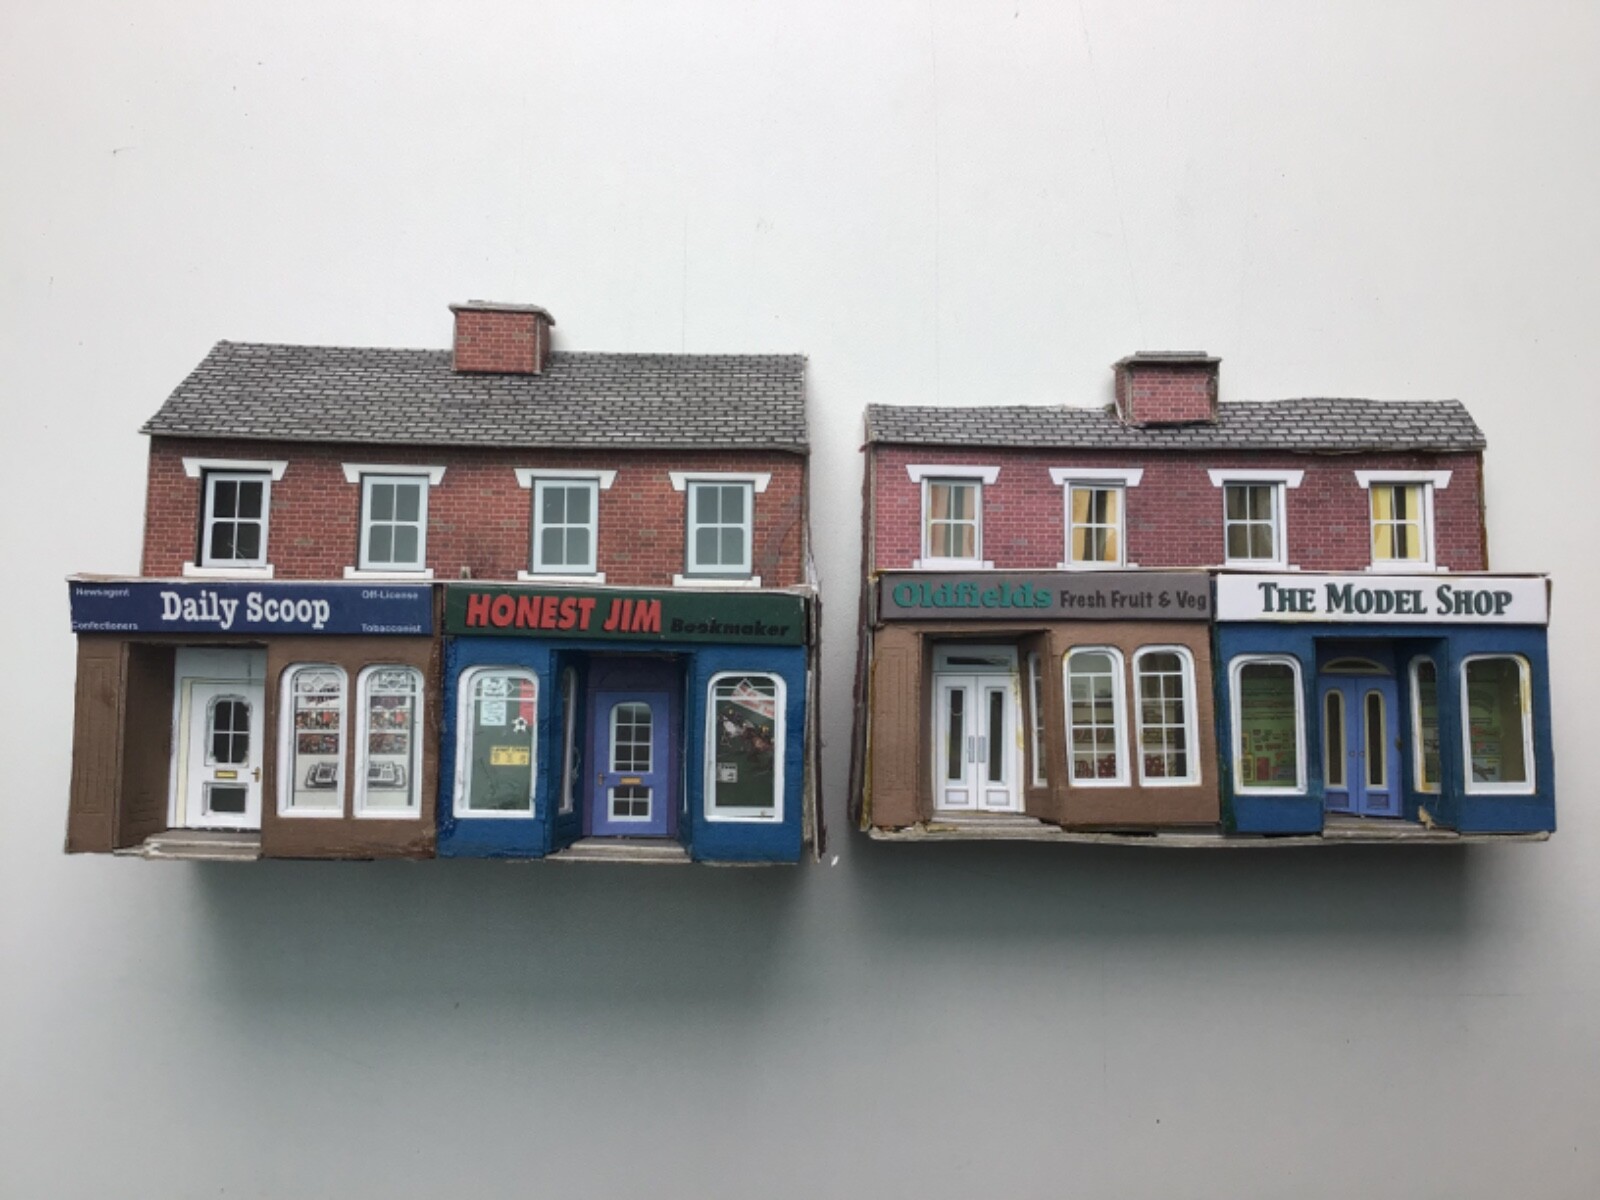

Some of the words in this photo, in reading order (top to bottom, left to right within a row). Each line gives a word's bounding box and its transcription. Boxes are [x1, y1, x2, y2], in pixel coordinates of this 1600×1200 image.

[75, 587, 130, 599] Newsagent
[892, 581, 1053, 609] Oldfields
[1060, 590, 1107, 609] Fresh
[1111, 590, 1153, 609] Fruit
[1158, 590, 1172, 609] &
[1176, 590, 1207, 611] Veg
[1258, 582, 1317, 613] THE
[1325, 583, 1428, 615] MODEL
[1436, 584, 1513, 616] SHOP
[160, 591, 238, 630] Daily
[246, 592, 330, 628] Scoop
[465, 594, 596, 630] HONEST
[603, 597, 662, 633] JIM
[360, 623, 422, 633] Tobacconist
[671, 617, 790, 637] Bookmaker
